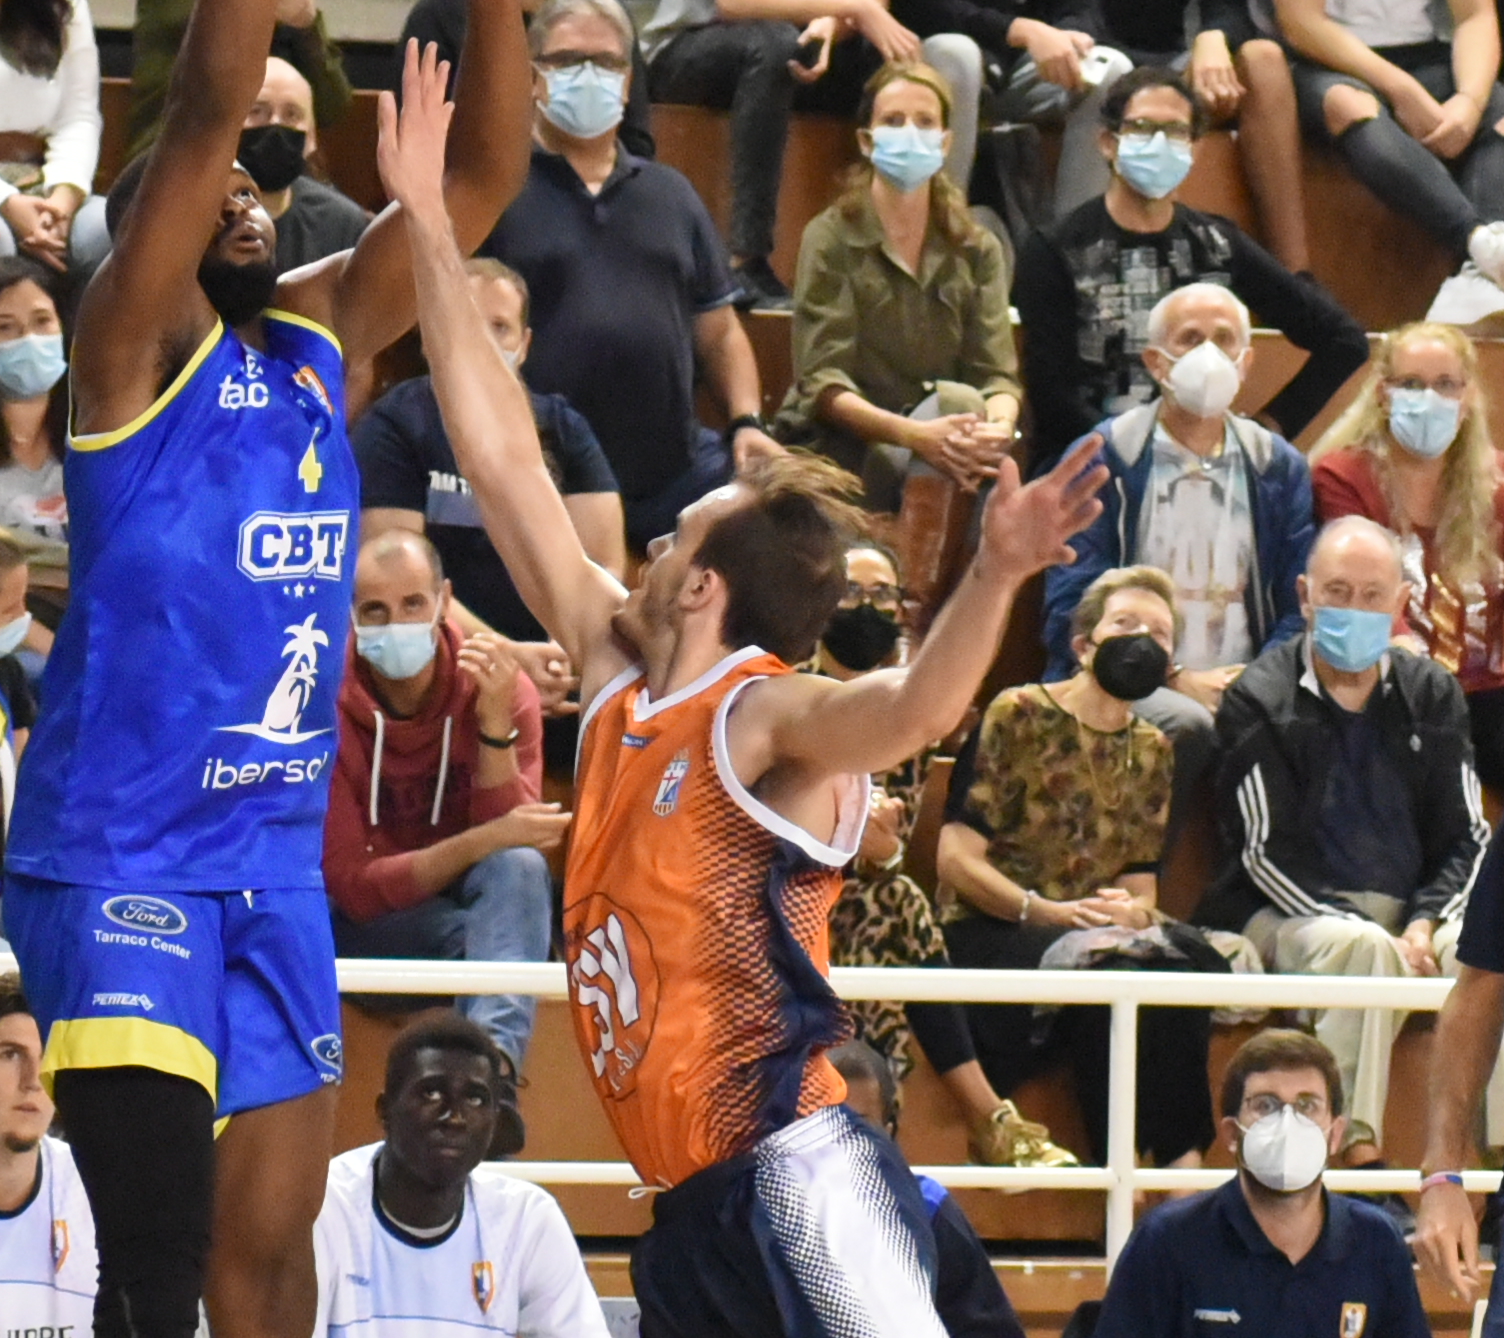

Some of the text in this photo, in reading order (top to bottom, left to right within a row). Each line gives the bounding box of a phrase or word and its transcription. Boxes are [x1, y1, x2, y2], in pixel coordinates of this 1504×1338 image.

[298, 426, 322, 493] 4
[241, 514, 348, 578] CBT
[123, 901, 170, 929] Ford
[93, 929, 192, 960] Tarraco Center
